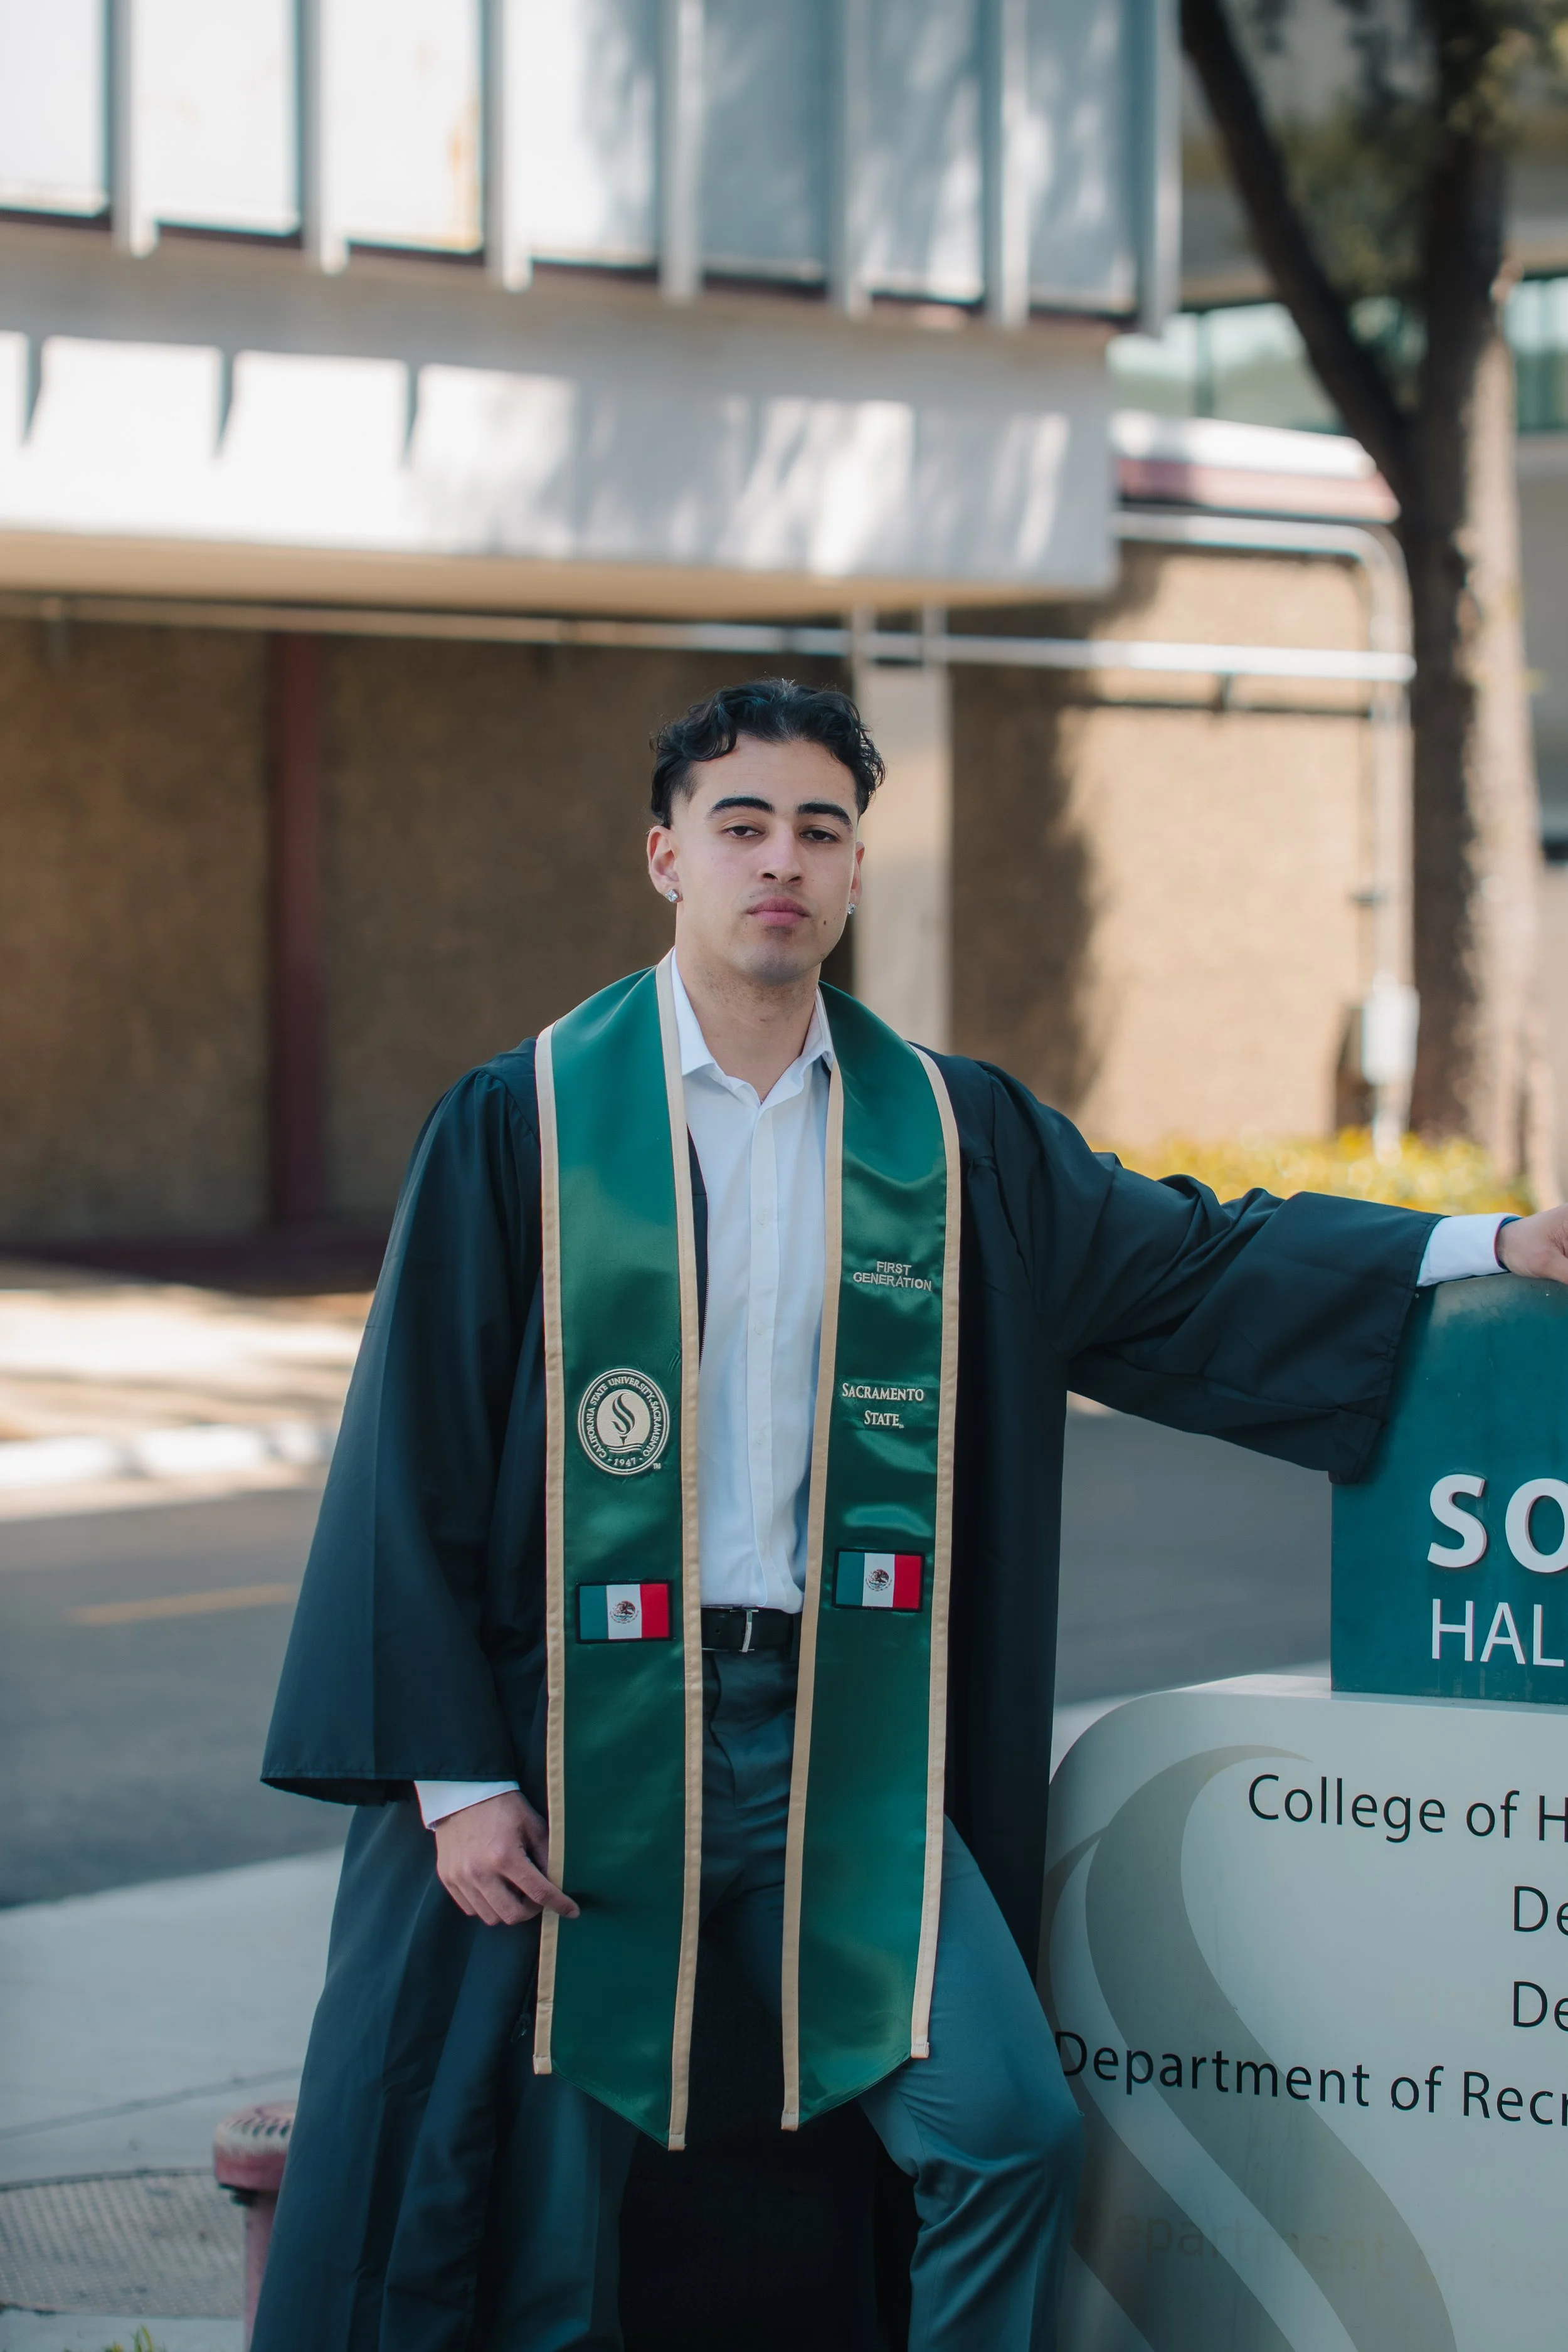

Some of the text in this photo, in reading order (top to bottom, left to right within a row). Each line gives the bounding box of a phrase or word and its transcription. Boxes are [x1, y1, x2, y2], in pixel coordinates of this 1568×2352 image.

[853, 1272, 932, 1291] GENERATION
[876, 1261, 911, 1276] FIRST
[590, 1383, 608, 1406] STATE
[586, 1407, 607, 1459] CALIFORNIA
[642, 1400, 662, 1457] SACRAMENTO
[613, 1457, 637, 1466] 1947
[1427, 1474, 1568, 1573] SO
[1431, 1599, 1565, 1667] HAL
[1248, 1774, 1568, 1843] College of H
[1055, 2031, 1370, 2108] Department
[1391, 2065, 1444, 2114] of
